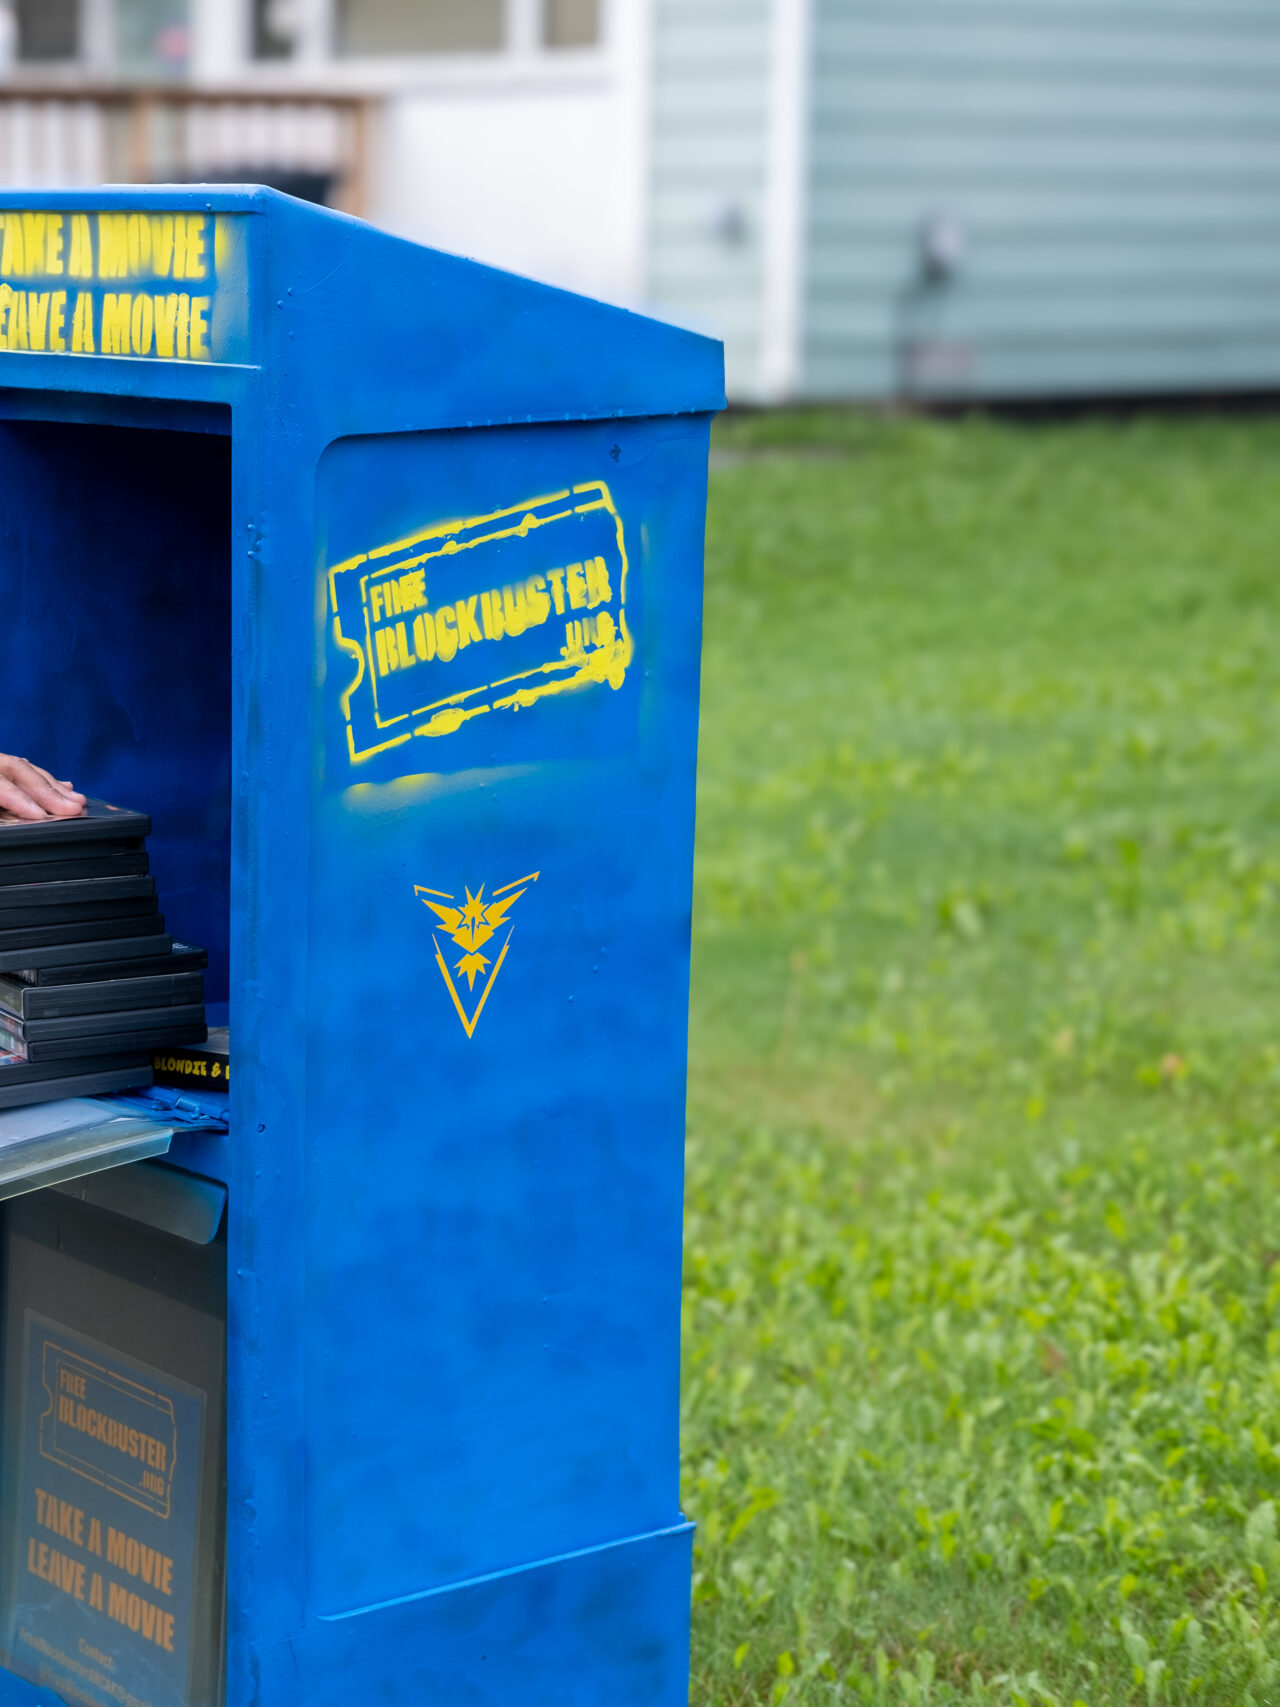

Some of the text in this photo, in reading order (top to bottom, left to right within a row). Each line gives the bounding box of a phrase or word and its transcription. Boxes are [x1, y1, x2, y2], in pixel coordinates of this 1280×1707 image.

[68, 213, 93, 278] A
[98, 213, 207, 279] MOVIE
[72, 291, 94, 353] A
[101, 292, 210, 358] MOVIE
[375, 556, 613, 677] BLOCKBUSTER
[154, 1055, 207, 1077] BLONDIE
[211, 1062, 222, 1078] &
[60, 1368, 86, 1400] FREE
[58, 1394, 167, 1472] BLOCKBUSTER
[35, 1487, 173, 1596] TAKE A MOVIE
[28, 1536, 175, 1653] LEAVE A MOVIE
